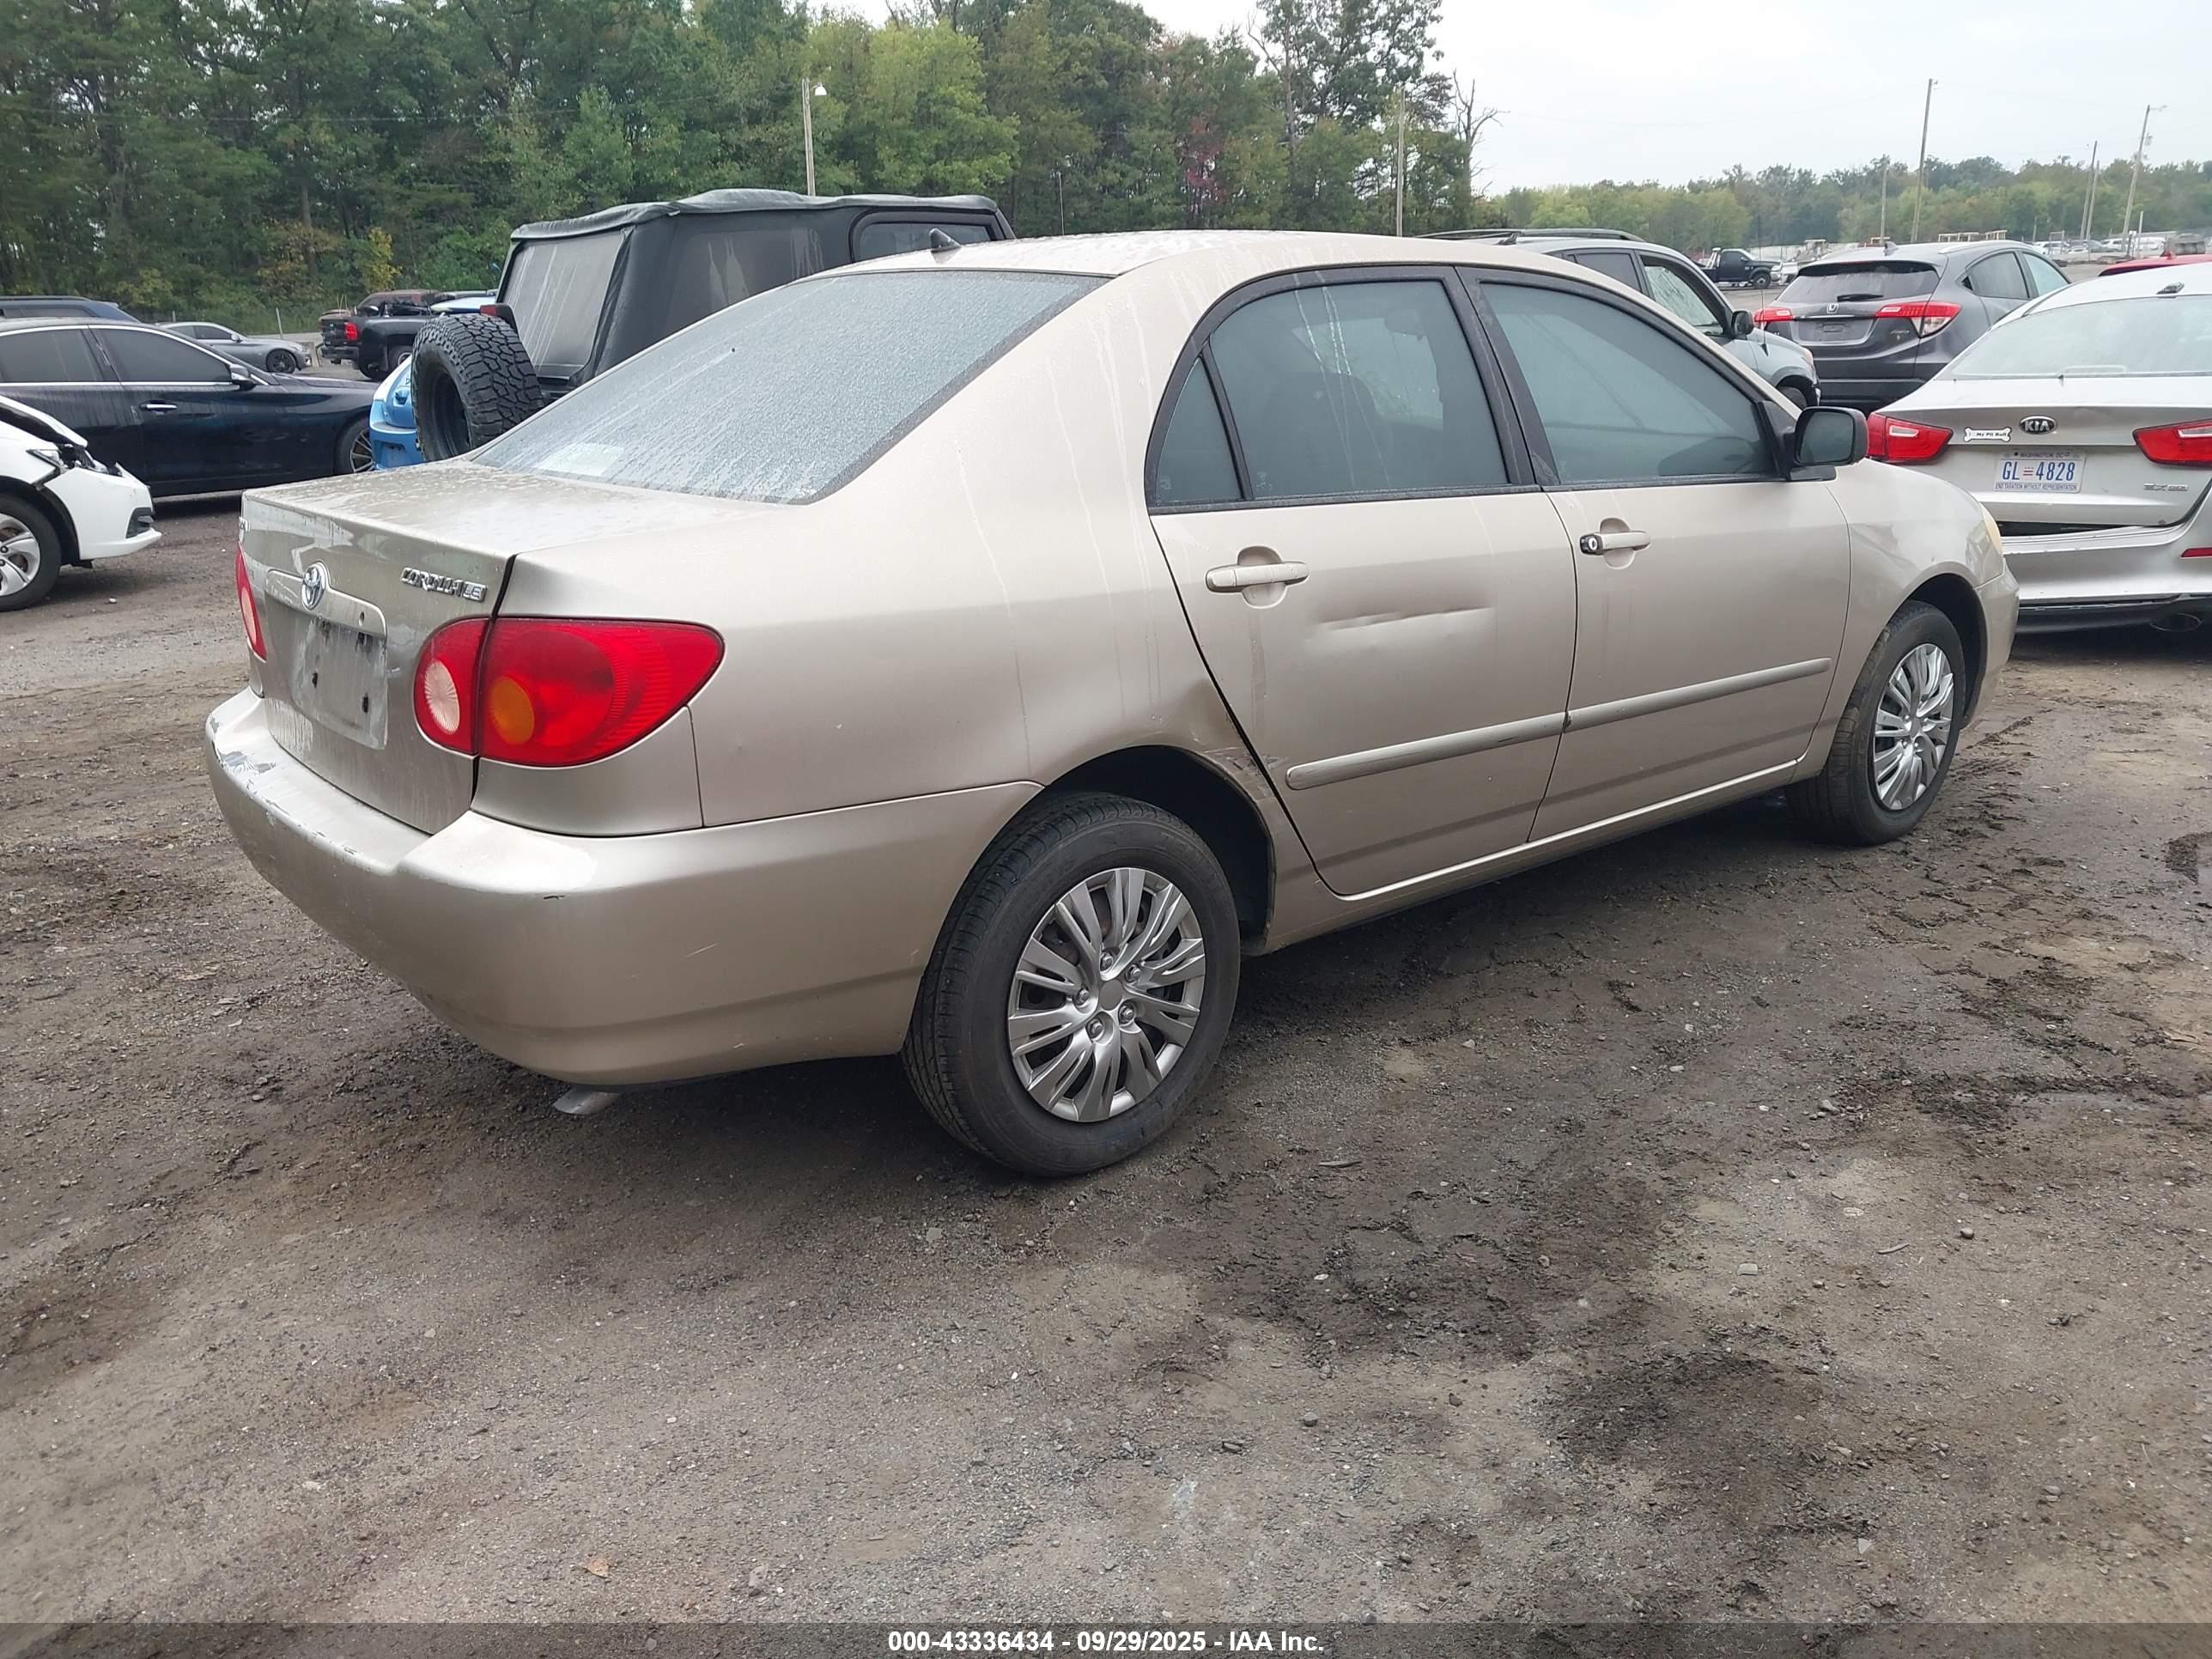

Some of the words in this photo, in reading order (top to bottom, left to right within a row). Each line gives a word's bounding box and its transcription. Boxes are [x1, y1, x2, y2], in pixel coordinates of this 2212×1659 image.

[2024, 420, 2051, 432] KIA
[2002, 461, 2021, 480] GL
[2036, 461, 2075, 481] 4828
